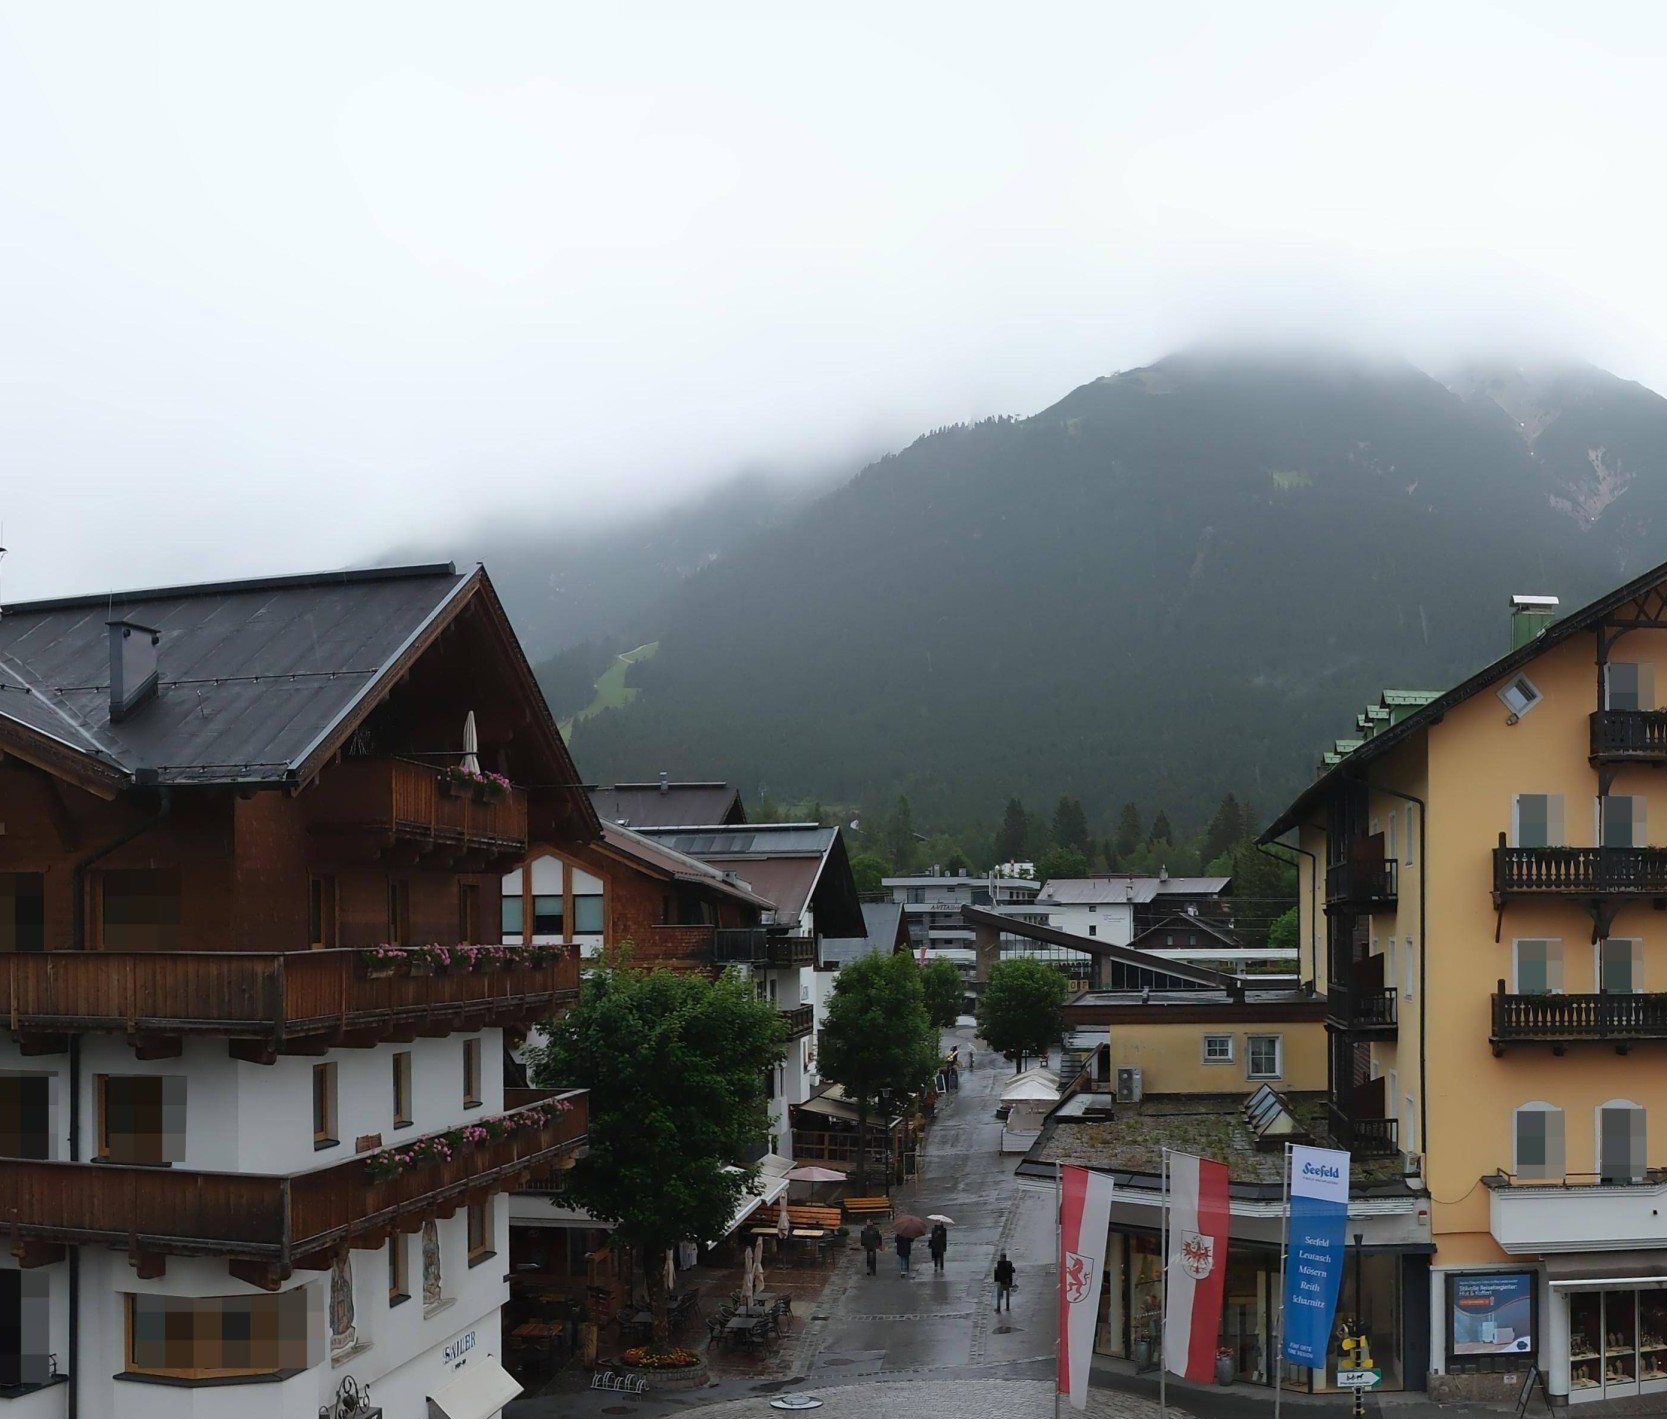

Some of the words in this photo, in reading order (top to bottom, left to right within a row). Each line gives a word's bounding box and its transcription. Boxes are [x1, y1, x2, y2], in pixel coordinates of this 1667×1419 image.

[1302, 1162, 1339, 1178] Seefeld
[1305, 1236, 1329, 1247] Seefeld
[1299, 1250, 1331, 1263] Leutasch
[1299, 1265, 1327, 1278] Mösern
[1301, 1281, 1320, 1292] Reith
